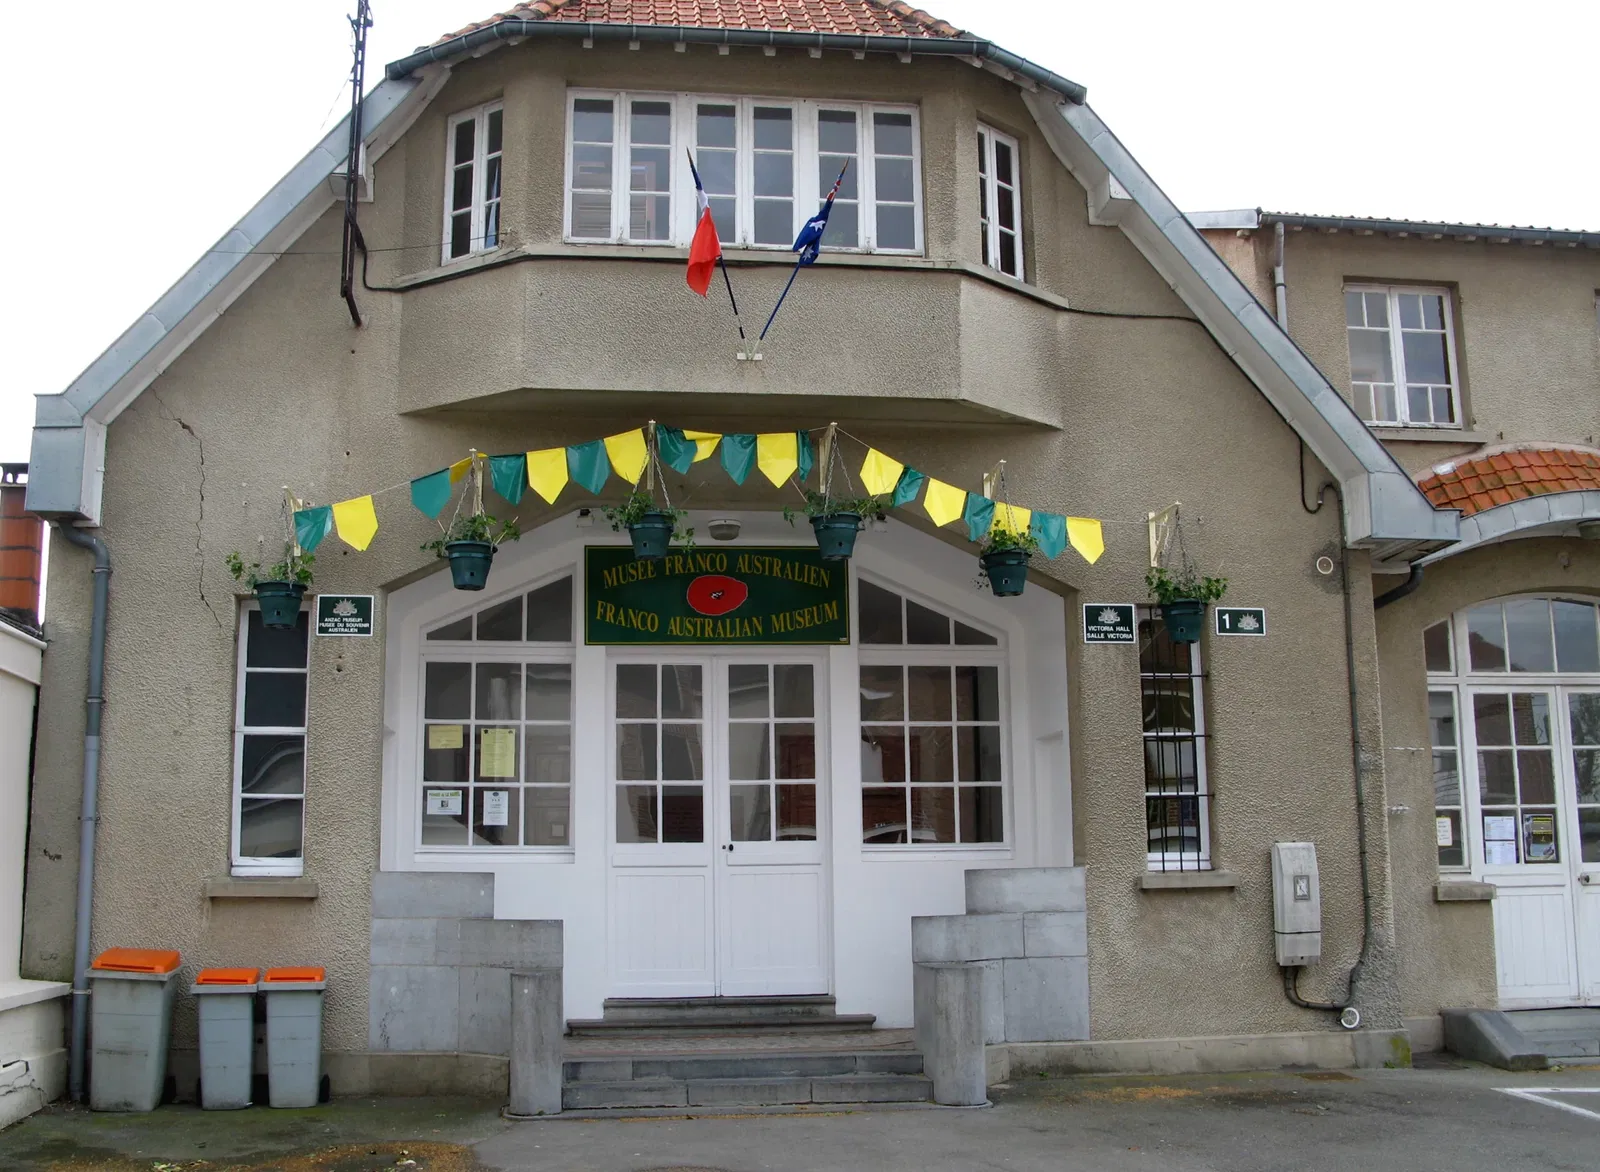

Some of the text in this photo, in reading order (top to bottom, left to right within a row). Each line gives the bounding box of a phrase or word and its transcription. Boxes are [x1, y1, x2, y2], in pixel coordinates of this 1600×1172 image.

[664, 553, 727, 576] FRANCO
[736, 554, 830, 588] AUSTRALIEN
[596, 600, 839, 638] FRANCO AUSTRALIAN MUSEUM
[1222, 613, 1230, 629] 1
